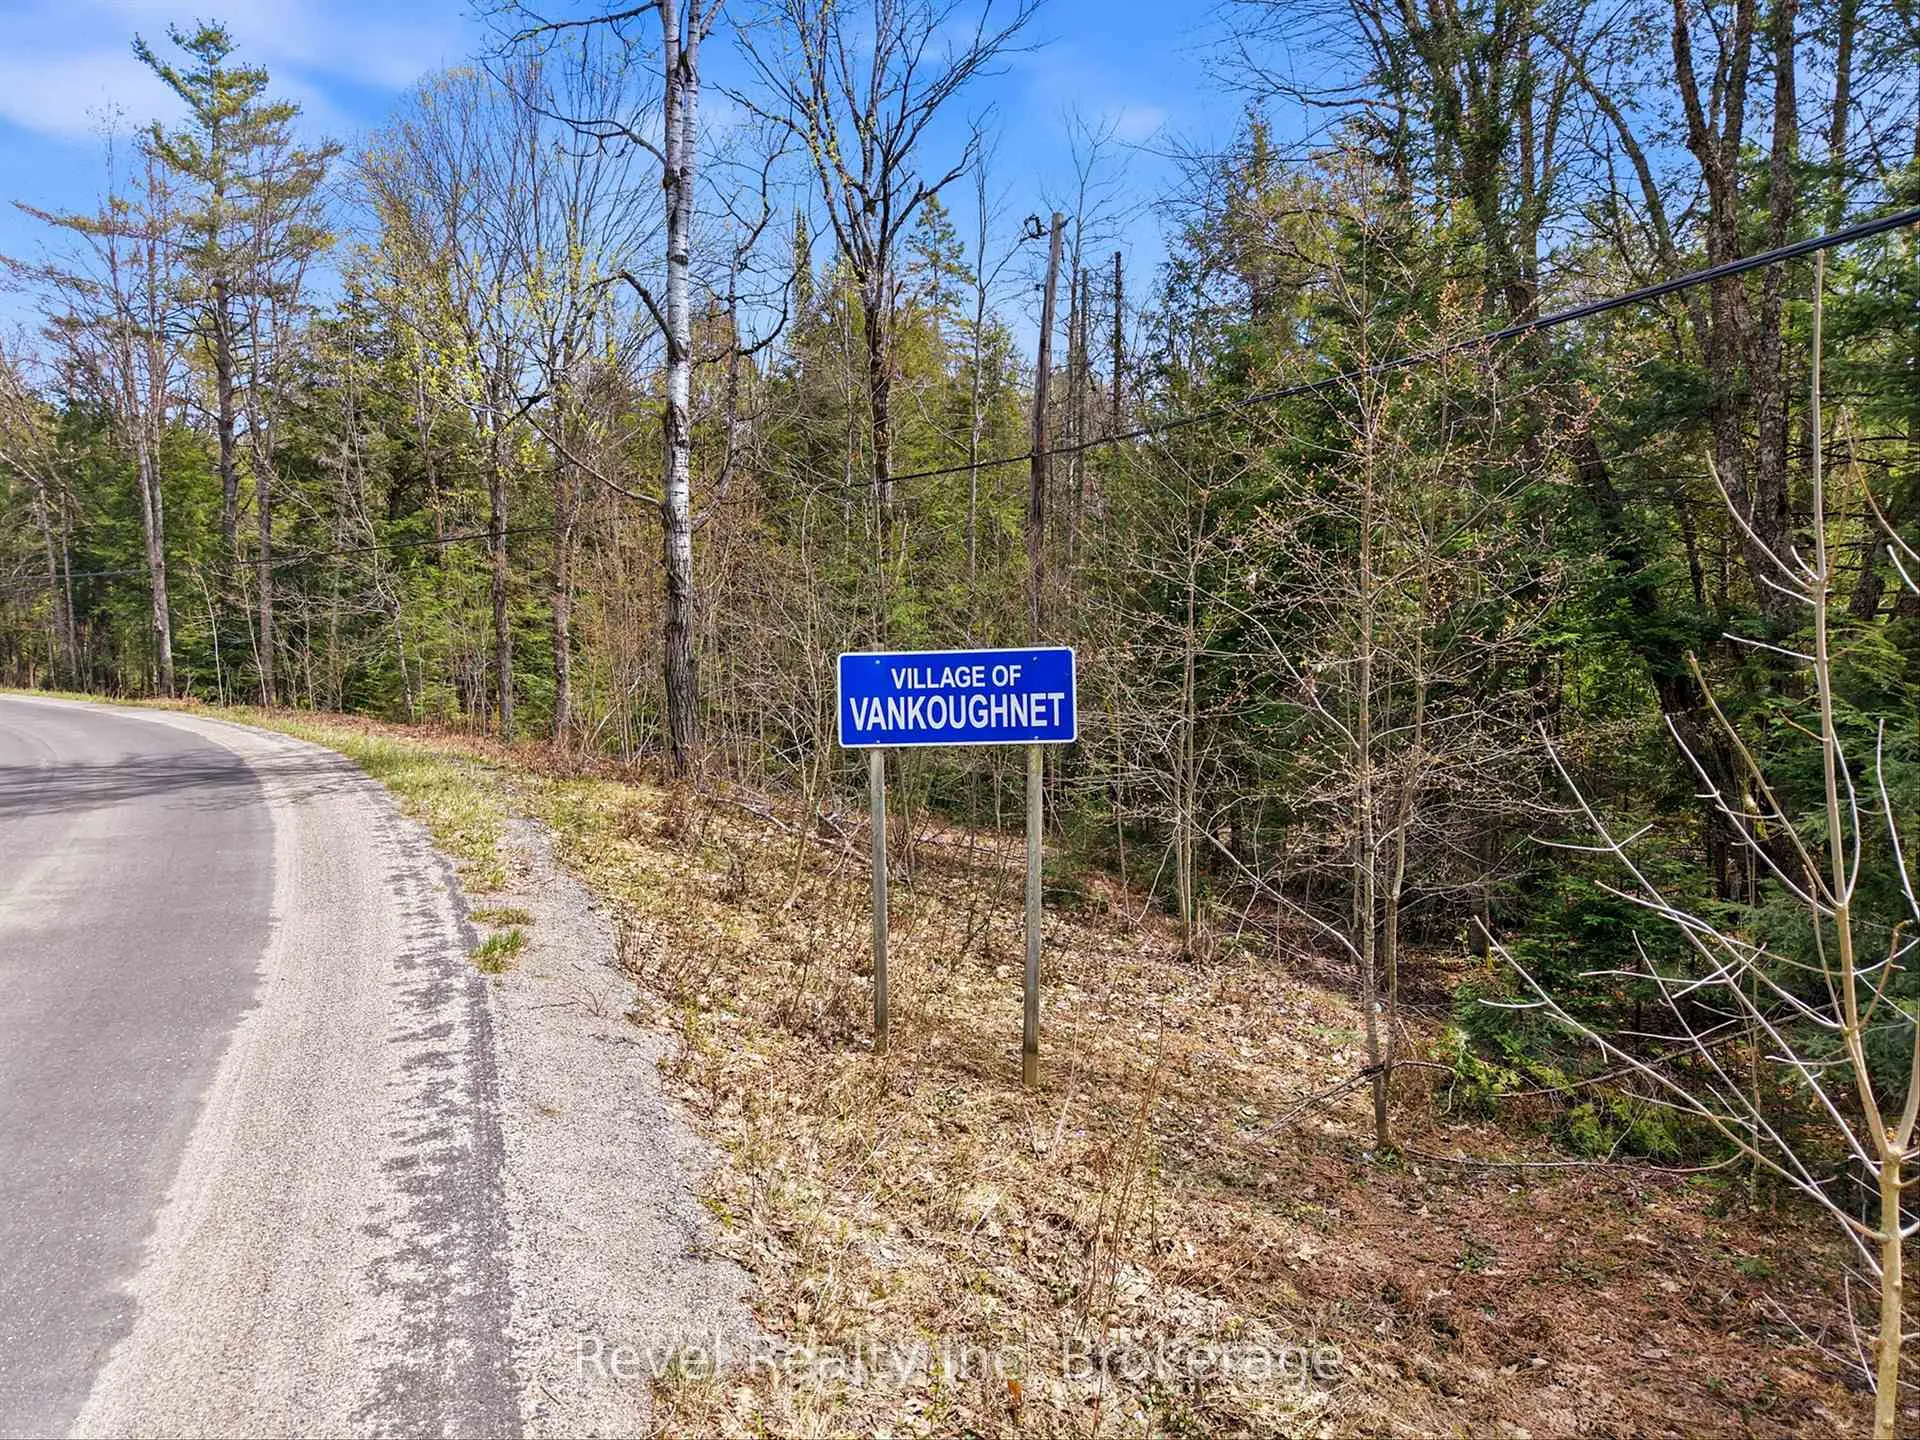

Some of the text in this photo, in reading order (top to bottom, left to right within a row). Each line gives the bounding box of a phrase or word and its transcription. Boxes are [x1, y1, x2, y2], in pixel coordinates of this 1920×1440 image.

[891, 665, 1021, 689] VILLAGE OF
[850, 693, 1064, 731] VANKOUGHNET
